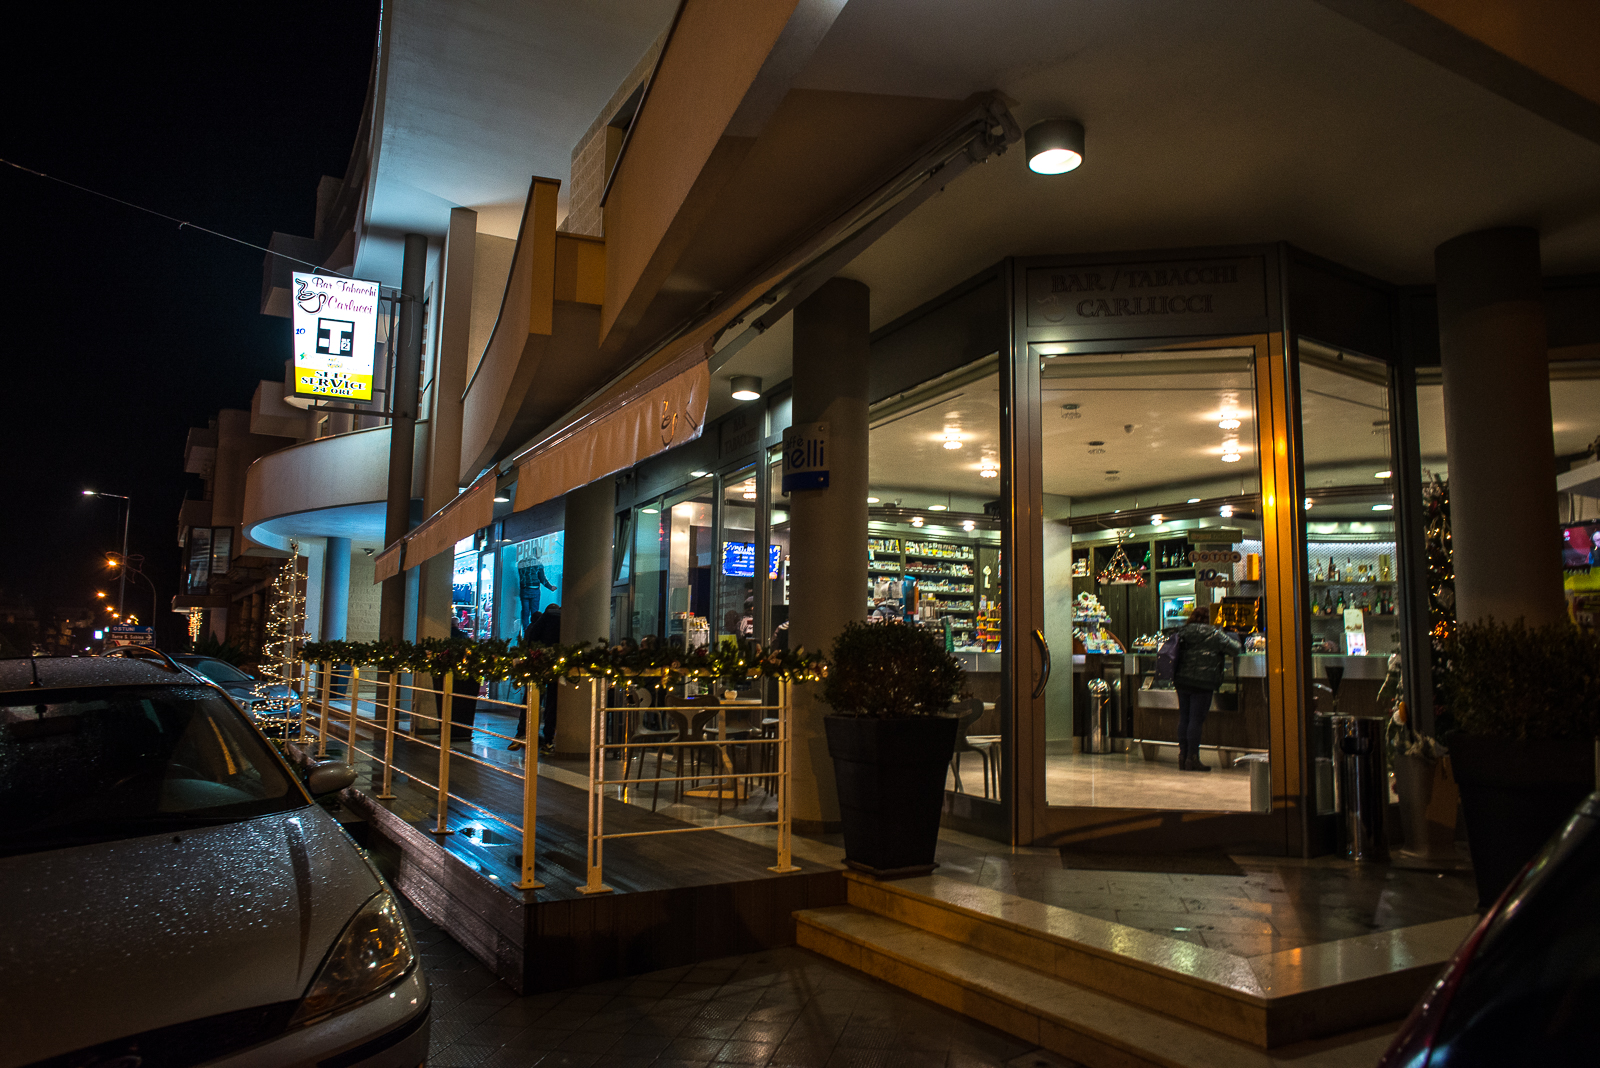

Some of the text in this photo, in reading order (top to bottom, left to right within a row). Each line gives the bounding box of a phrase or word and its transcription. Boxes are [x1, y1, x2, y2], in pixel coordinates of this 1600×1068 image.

[311, 276, 377, 297] Bar Tabacchi
[1051, 272, 1106, 293] BAR
[1123, 265, 1238, 288] TABACCHI
[327, 295, 373, 315] Carlucci
[1076, 294, 1213, 317] CARLUCCI
[301, 377, 366, 390] SERVICE
[330, 388, 354, 396] ORE
[784, 434, 804, 451] affè
[516, 535, 556, 562] PRINCE
[1190, 551, 1240, 562] LOTTO
